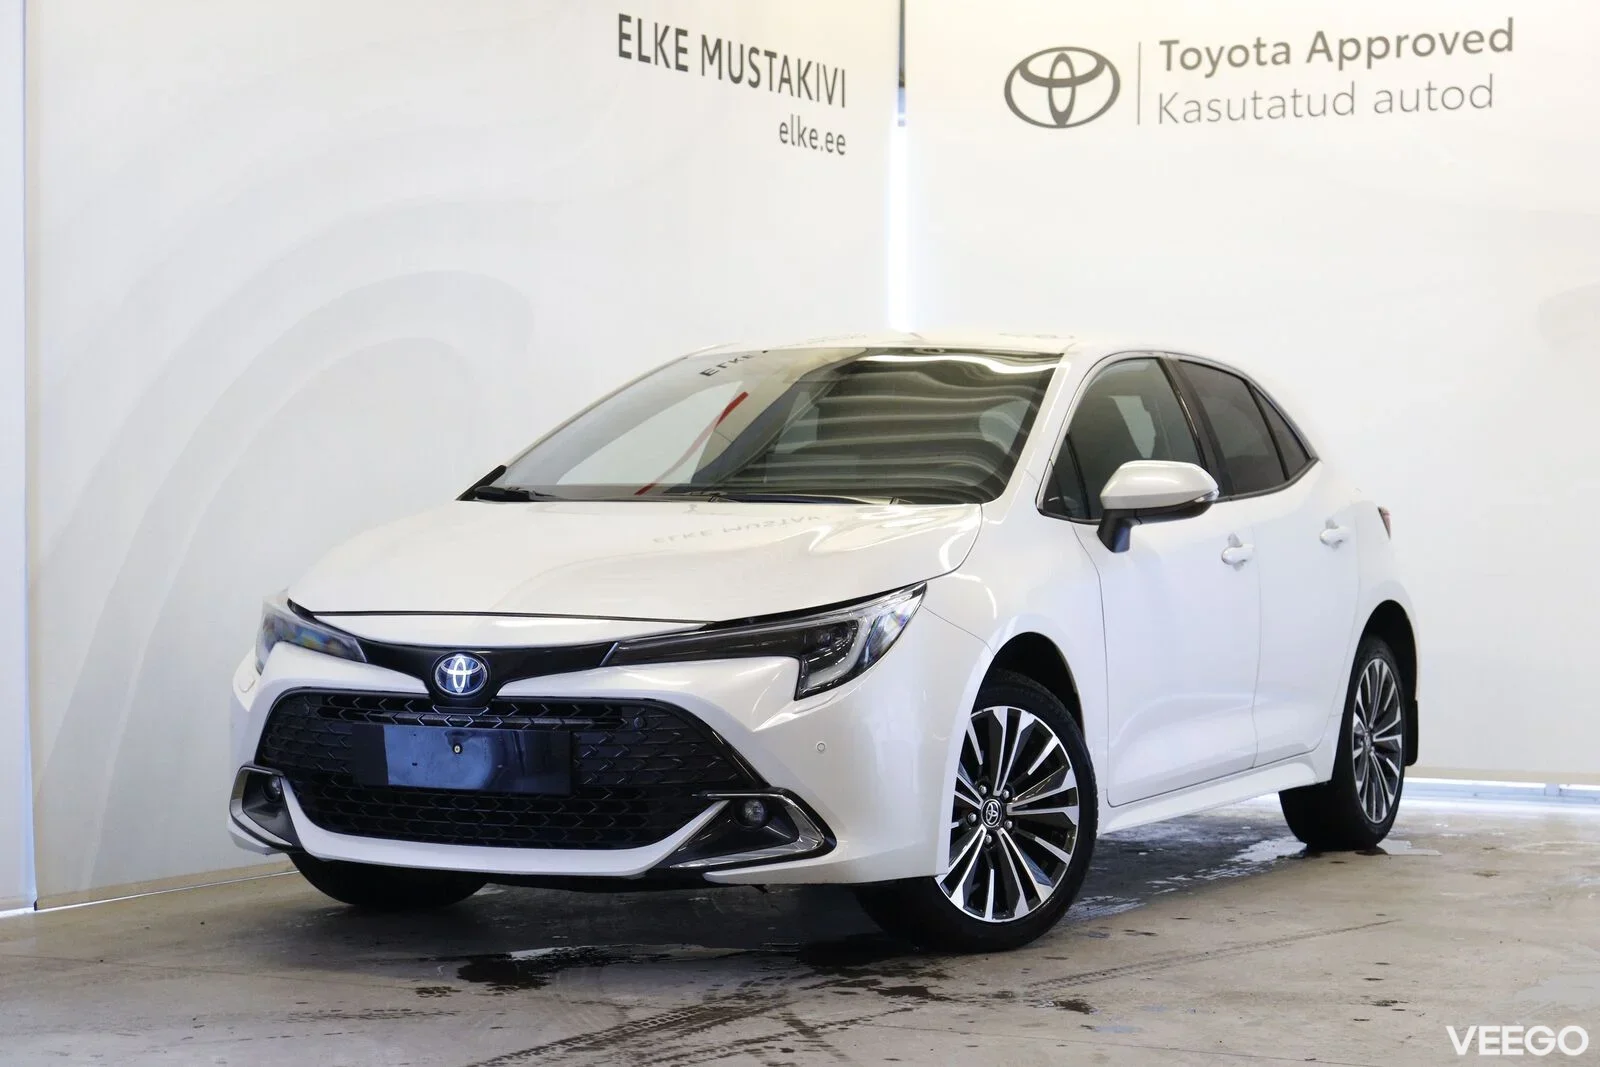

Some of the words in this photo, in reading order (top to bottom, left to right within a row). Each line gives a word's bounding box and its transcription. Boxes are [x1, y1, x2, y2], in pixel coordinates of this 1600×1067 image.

[618, 13, 689, 73] ELKE
[701, 34, 846, 109] MUSTAKIVI
[1159, 36, 1292, 79] Toyota
[1306, 17, 1514, 71] Approved
[1158, 81, 1356, 125] Kasutatud
[1373, 73, 1494, 114] autod
[779, 113, 846, 156] elke.ee
